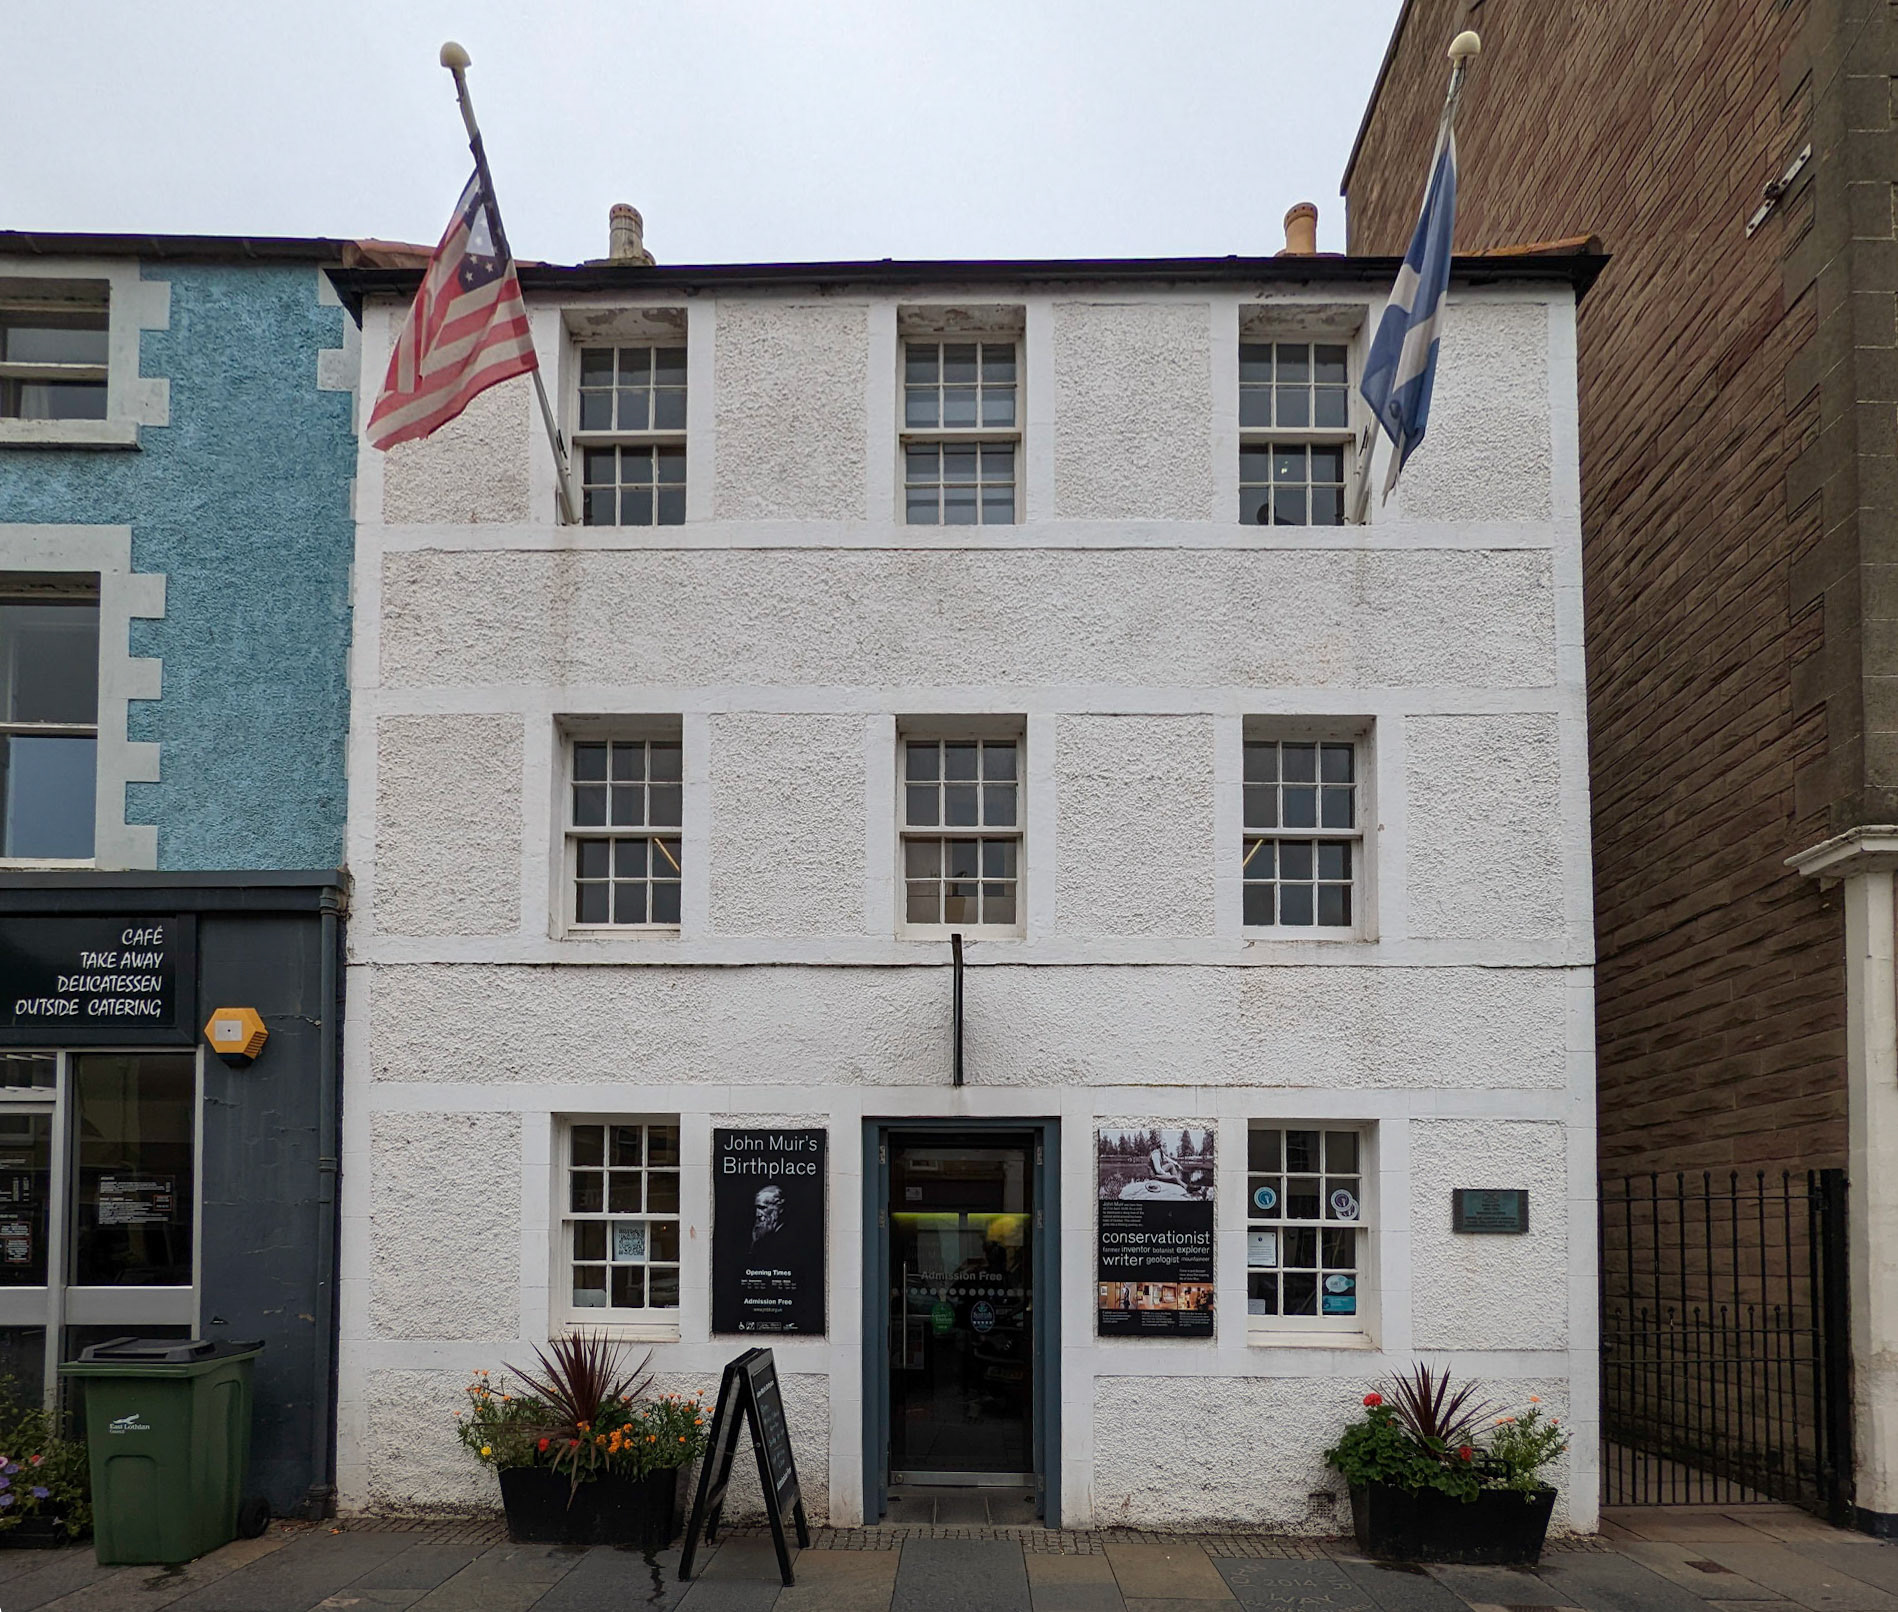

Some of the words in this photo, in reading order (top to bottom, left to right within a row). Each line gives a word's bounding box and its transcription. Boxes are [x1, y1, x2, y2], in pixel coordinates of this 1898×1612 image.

[122, 925, 163, 946] CAFÉ
[80, 952, 117, 969] TAKE
[120, 952, 164, 970] AWAY
[57, 975, 162, 993] DELICATESSEN
[15, 998, 79, 1016] OUTSIDE
[88, 998, 162, 1018] CATERING
[724, 1135, 764, 1151] John
[769, 1135, 818, 1152] Muir's
[723, 1157, 817, 1179] Birthplace
[1102, 1230, 1210, 1245] conservationist
[1121, 1245, 1151, 1253] inventor
[1176, 1245, 1210, 1255] explorer
[1102, 1253, 1144, 1266] writer
[1146, 1255, 1179, 1265] geologist
[745, 1269, 772, 1277] Opening
[921, 1271, 976, 1281] Admission
[979, 1271, 1003, 1281] Free
[1264, 1579, 1317, 1588] 2014
[1270, 1592, 1335, 1605] WAY
